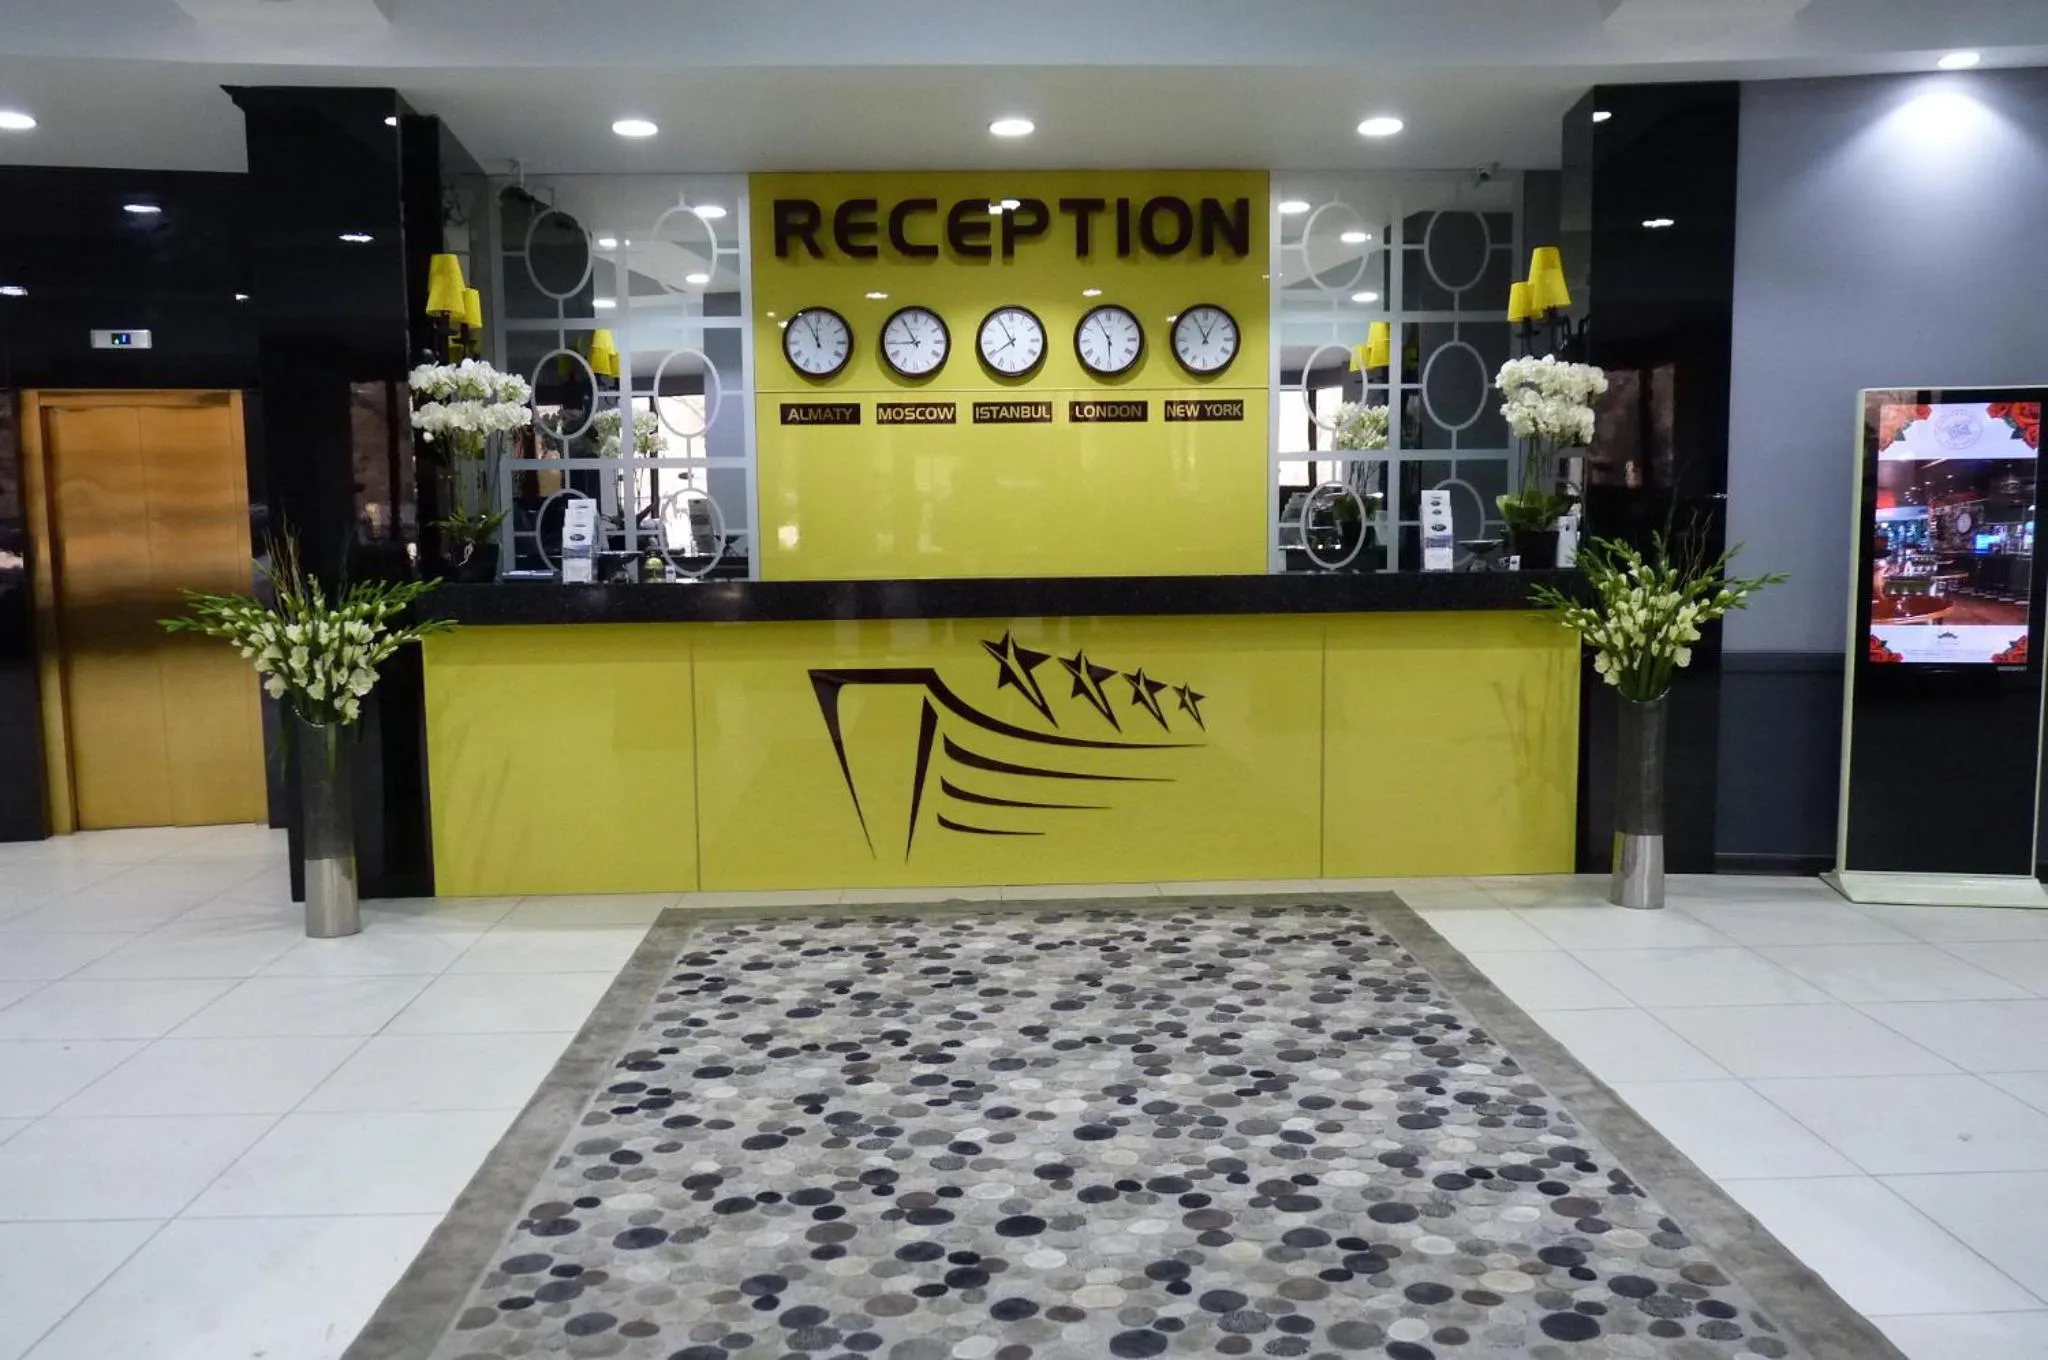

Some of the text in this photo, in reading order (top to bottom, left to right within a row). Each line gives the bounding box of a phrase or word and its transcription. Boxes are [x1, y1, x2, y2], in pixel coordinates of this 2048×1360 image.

[773, 196, 1250, 258] RECEPTION
[788, 408, 853, 421] ALMATY
[878, 407, 955, 420] MOSCOW
[975, 406, 1050, 419] ISTANBUL
[1075, 405, 1142, 418] LONDON
[1167, 403, 1243, 417] NEW YORK
